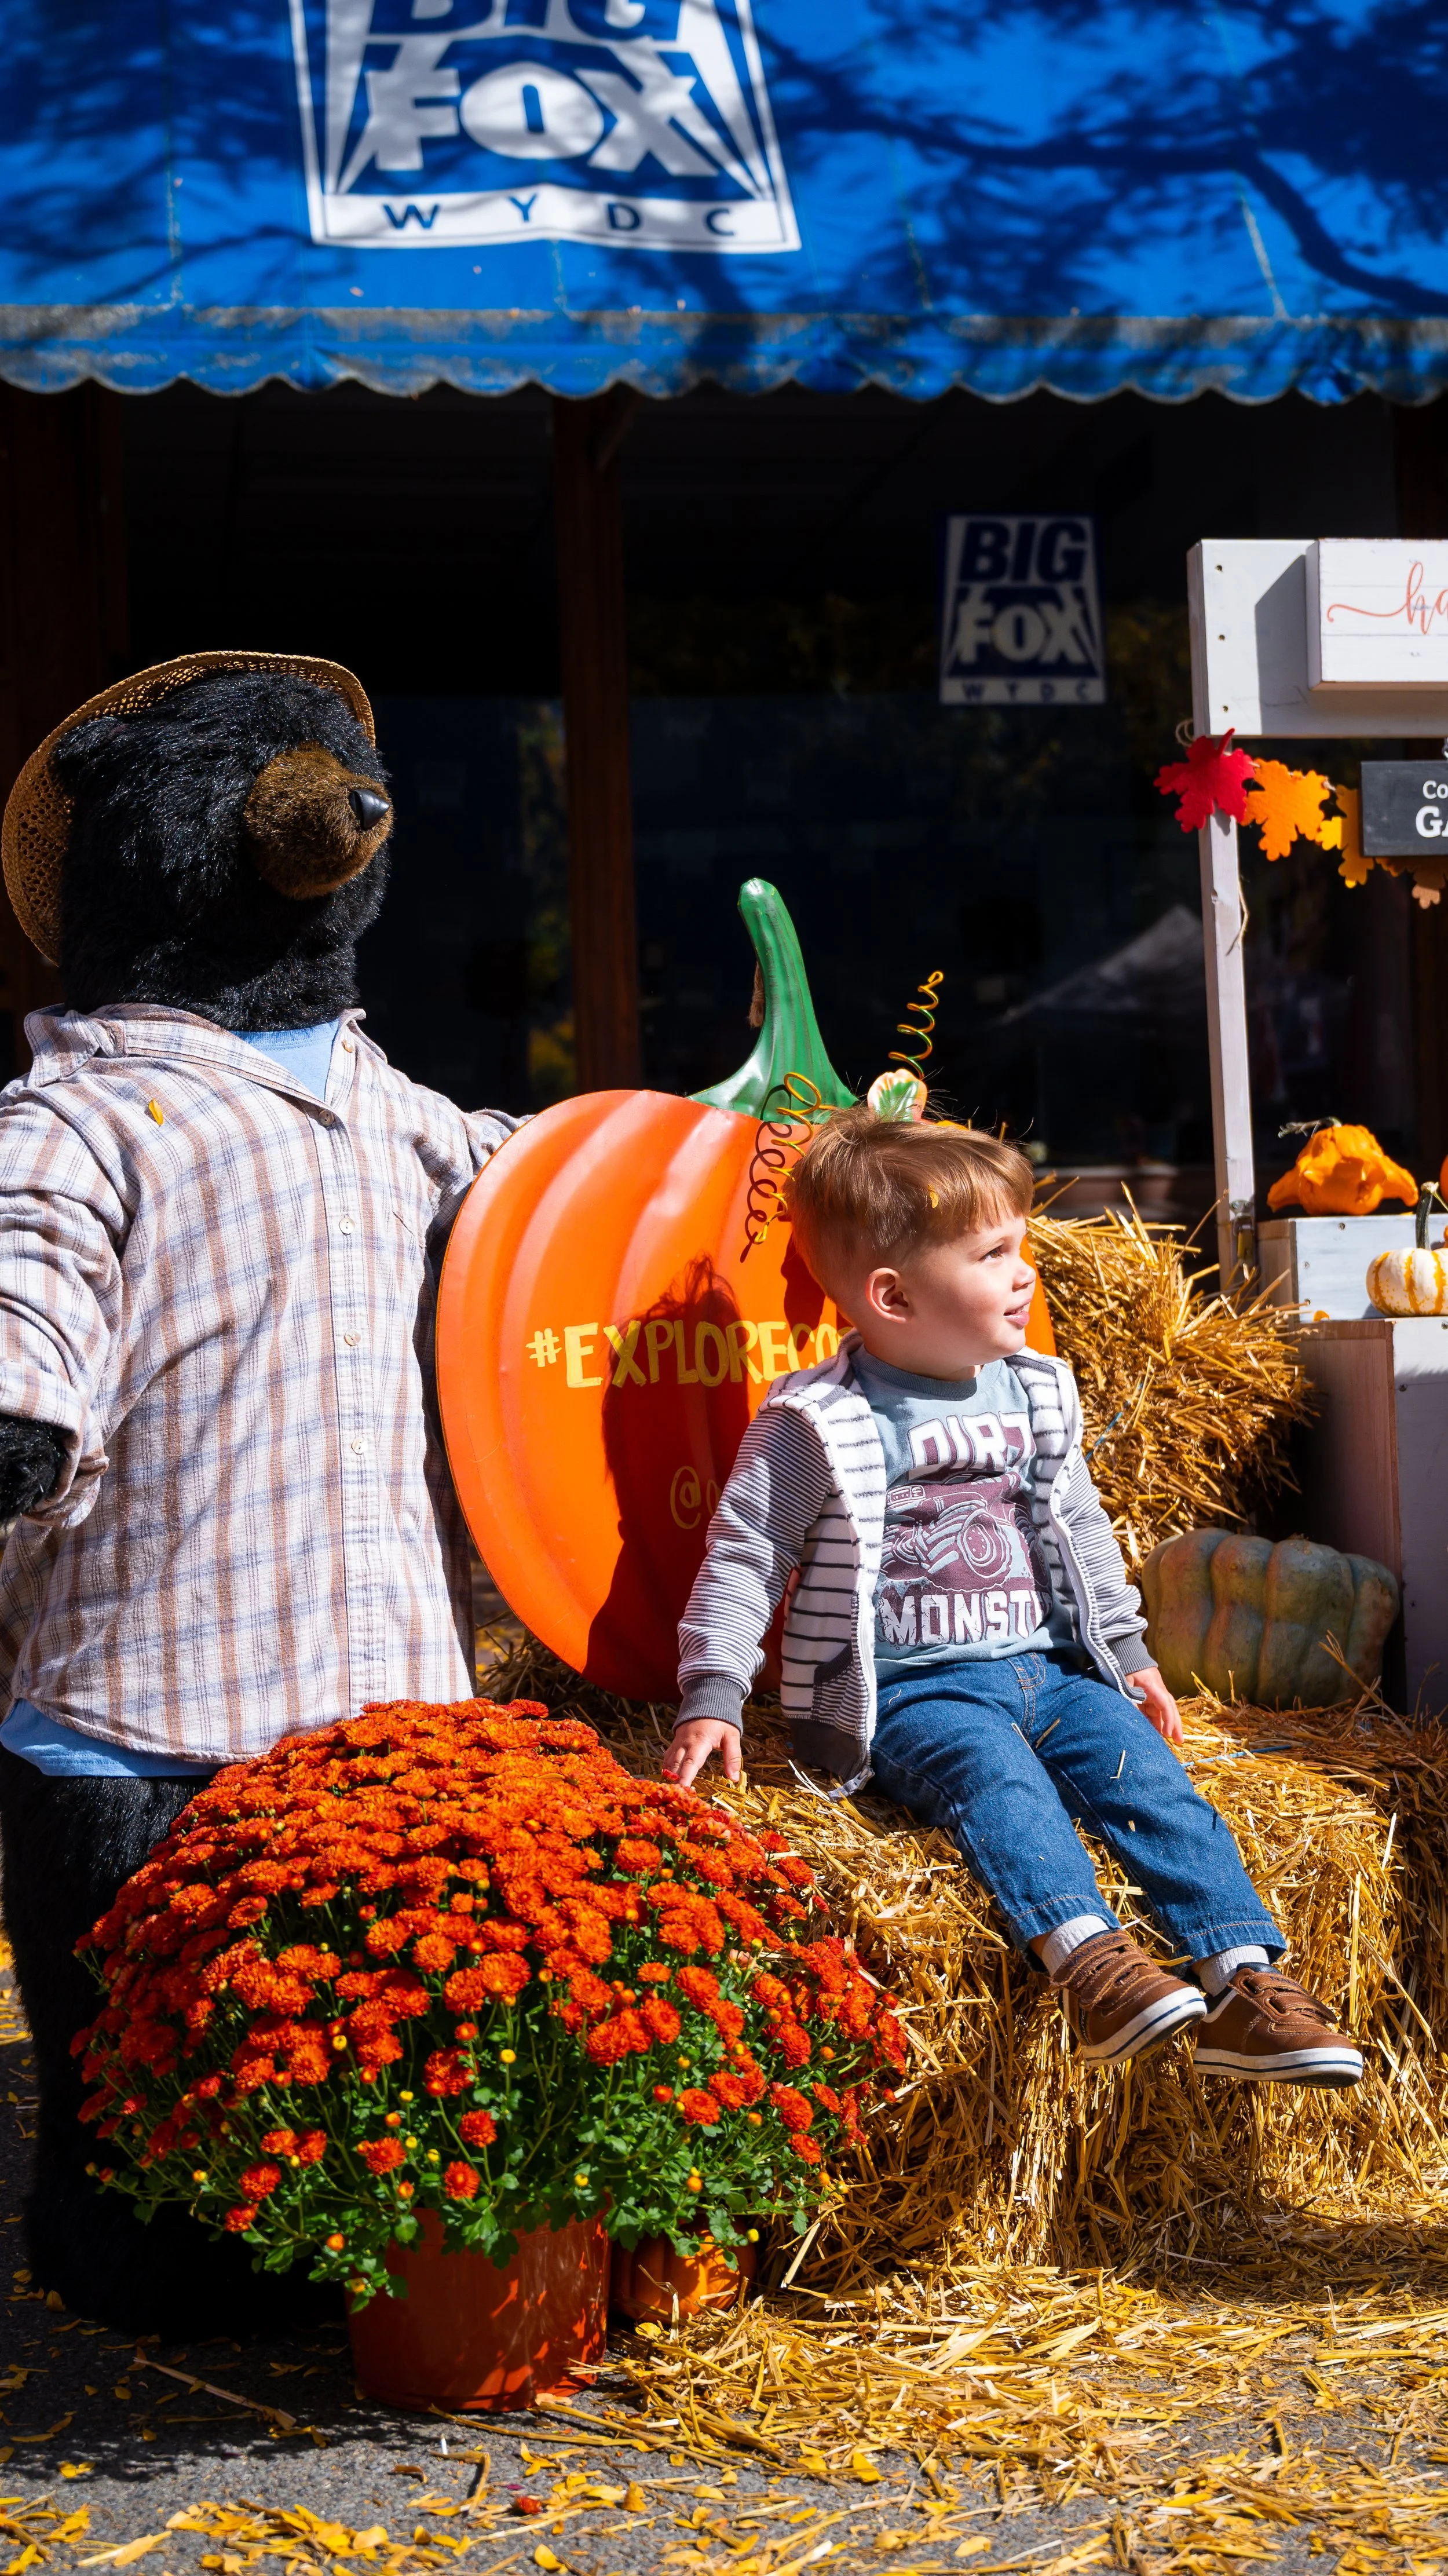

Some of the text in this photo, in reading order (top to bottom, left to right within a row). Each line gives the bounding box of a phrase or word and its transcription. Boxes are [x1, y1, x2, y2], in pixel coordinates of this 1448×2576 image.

[366, 61, 719, 176] FOX
[959, 522, 1087, 582] BIG
[956, 601, 1088, 665] FOX
[1423, 780, 1448, 799] Co
[1415, 805, 1448, 838] G
[525, 1320, 853, 1388] #EXPLORECO
[1066, 1936, 1122, 1967] NAUTICA
